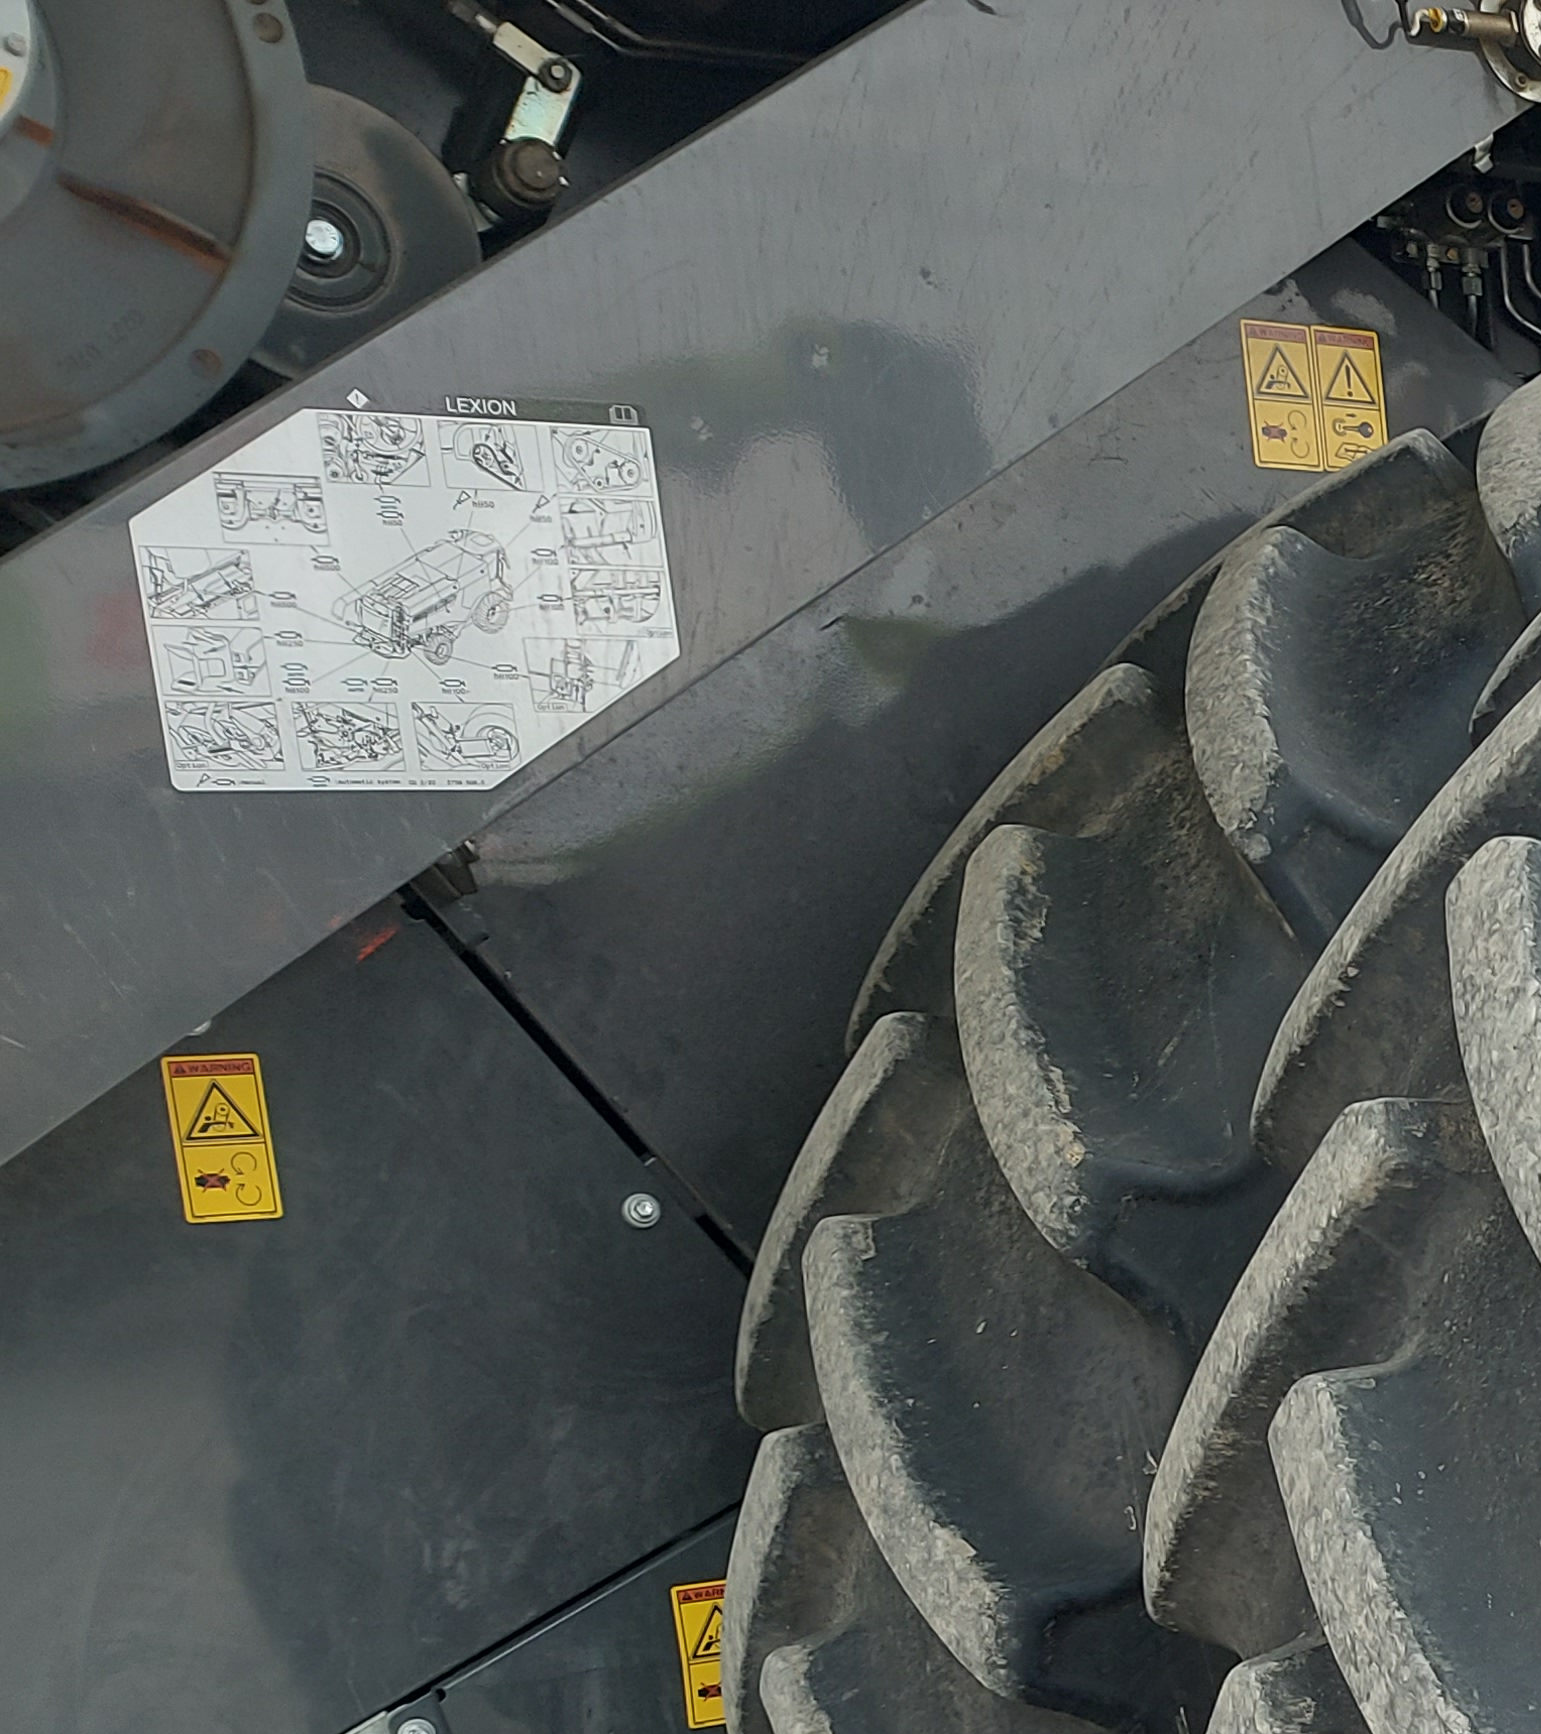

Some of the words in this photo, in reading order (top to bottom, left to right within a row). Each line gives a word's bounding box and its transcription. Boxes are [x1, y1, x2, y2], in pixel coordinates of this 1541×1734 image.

[445, 396, 518, 416] LEXION
[188, 1062, 252, 1074] WARNING
[693, 1588, 726, 1600] WARN
